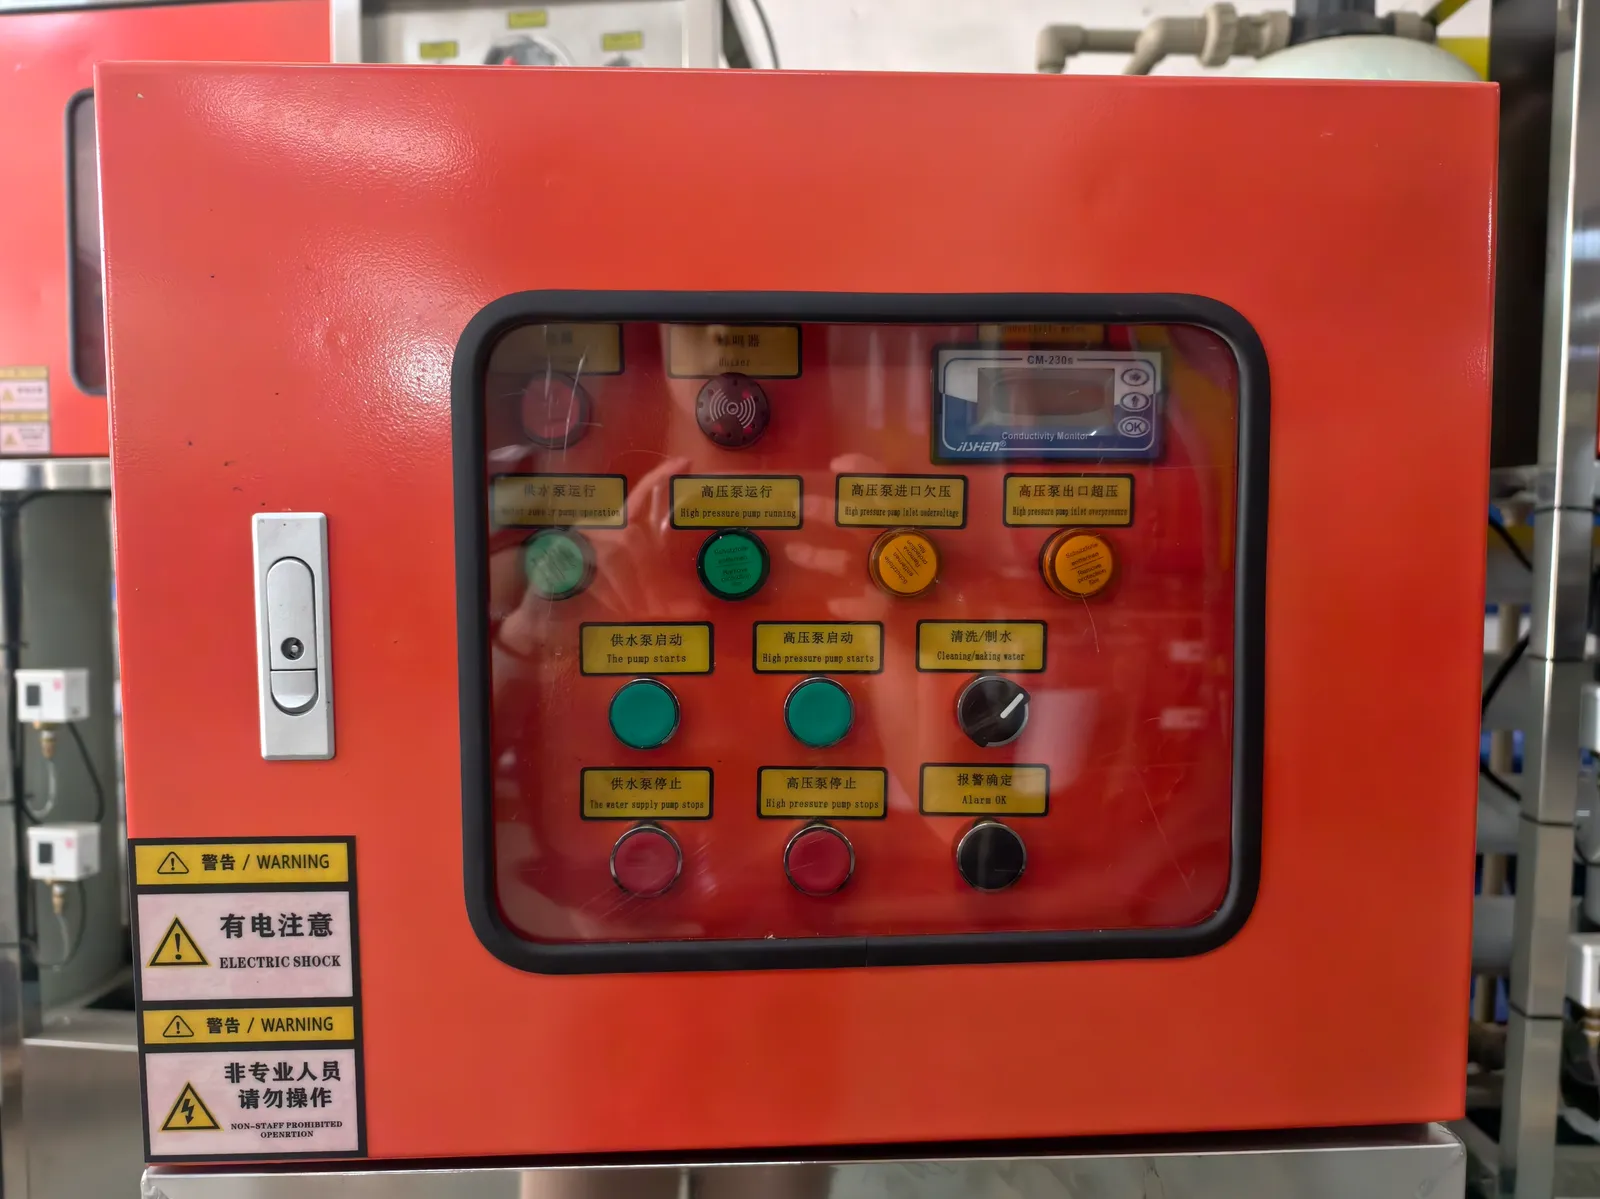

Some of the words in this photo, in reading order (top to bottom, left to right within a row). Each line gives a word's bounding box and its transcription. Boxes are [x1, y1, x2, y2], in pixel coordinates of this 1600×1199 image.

[1027, 355, 1073, 365] CM-230s
[1125, 421, 1142, 433] OK
[1001, 432, 1055, 442] Conductivity
[1056, 432, 1089, 441] Monitor
[701, 485, 772, 498] 高压泵运行
[851, 483, 951, 498] 高压泵进口欠压
[1019, 484, 1118, 498] 高压泵出口超压
[680, 508, 699, 519] High
[702, 509, 739, 519] pressure
[743, 510, 761, 519] pump
[764, 508, 796, 519] running
[845, 506, 858, 517] High
[860, 507, 886, 518] pressure
[888, 508, 900, 518] pump
[903, 507, 918, 517] inlet
[920, 507, 959, 519] undervoltage
[1013, 506, 1026, 517] High
[1027, 507, 1054, 518] pressure
[1056, 508, 1069, 518] pump
[1071, 506, 1086, 516] inlet
[1088, 507, 1128, 518] overpressure
[611, 633, 682, 647] 供水泵启动
[783, 631, 853, 644] 高压泵启动
[951, 630, 1012, 643] 清洗/制水
[607, 654, 624, 663] The
[627, 655, 650, 664] pump
[653, 654, 687, 663] starts
[763, 653, 781, 664] High
[784, 654, 822, 664] pressure
[825, 655, 844, 664] pump
[847, 654, 875, 663] starts
[937, 650, 1001, 662] Cleaning/making
[1003, 653, 1025, 661] water
[611, 777, 682, 790] 供水泵停止
[787, 776, 857, 790] 高压泵停止
[957, 773, 1013, 786] 报警确定
[590, 799, 603, 809] The
[606, 800, 629, 809] water
[631, 800, 658, 810] supply
[661, 801, 679, 810] pump
[682, 800, 704, 810] stops
[766, 798, 786, 809] High
[789, 800, 828, 809] pressure
[832, 800, 851, 810] pump
[855, 799, 879, 810] stops
[962, 795, 991, 805] Alarm
[995, 795, 1007, 805] OK
[202, 853, 236, 871] 警告
[257, 854, 330, 870] WARNING
[220, 911, 333, 939] 有电注意
[219, 956, 291, 969] ELECTRIC
[293, 955, 342, 968] SHOCK
[206, 1017, 240, 1034] 警告
[261, 1016, 334, 1032] WARNING
[224, 1061, 342, 1084] 非专业人员
[238, 1087, 333, 1110] 请勿操作
[231, 1121, 285, 1131] NON-STAFF
[286, 1120, 343, 1130] PROHIBITED
[260, 1130, 314, 1139] OPENRTION
